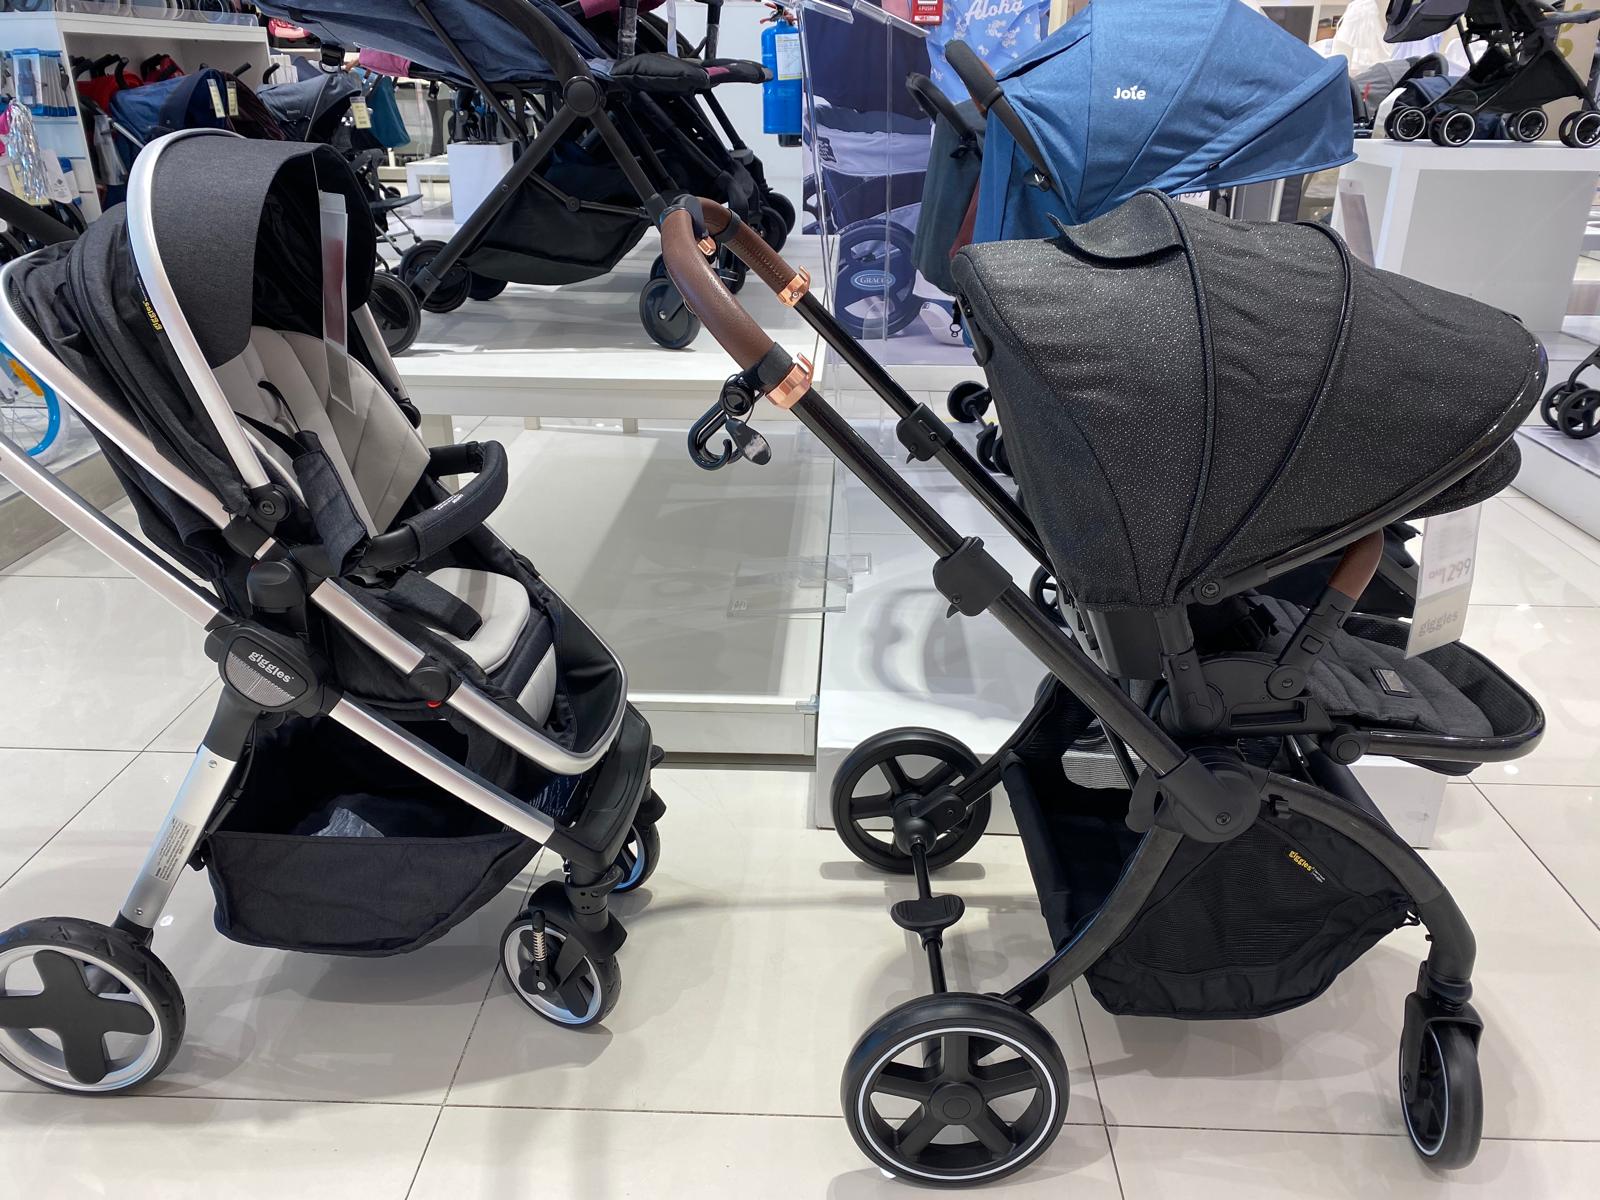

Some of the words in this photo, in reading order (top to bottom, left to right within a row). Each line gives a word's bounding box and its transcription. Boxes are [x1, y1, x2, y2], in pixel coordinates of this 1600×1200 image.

[1113, 85, 1147, 100] Joie
[248, 651, 291, 683] giggles
[1289, 850, 1313, 872] giggles
